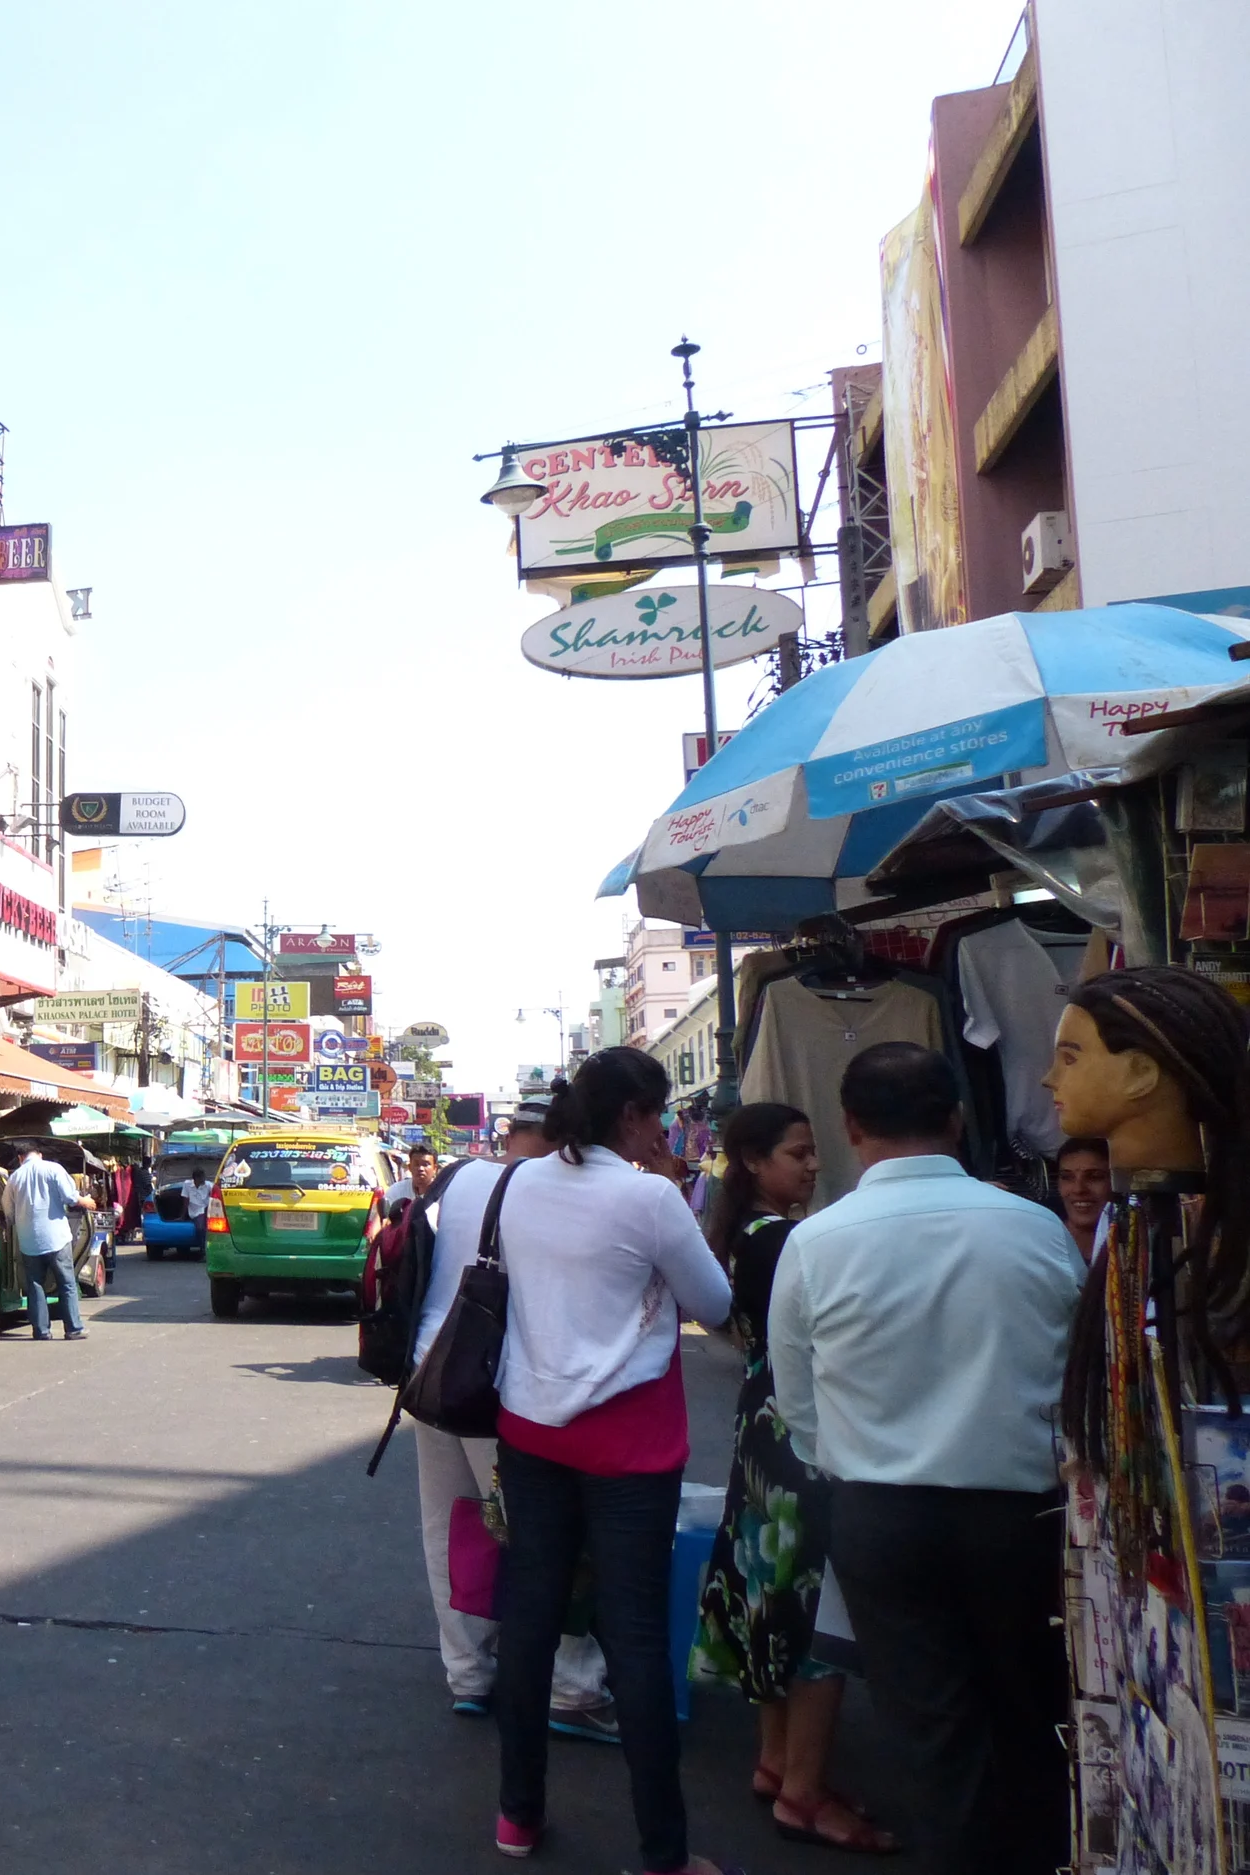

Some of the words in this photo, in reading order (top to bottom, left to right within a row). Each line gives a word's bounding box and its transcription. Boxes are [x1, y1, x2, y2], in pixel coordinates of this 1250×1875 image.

[525, 480, 641, 519] Khao
[610, 647, 661, 669] Irish
[1089, 700, 1170, 720] Happy
[853, 734, 926, 762] Available
[929, 731, 946, 744] at
[950, 719, 983, 738] any
[833, 746, 946, 786] convenience
[950, 729, 1009, 755] stores
[132, 797, 172, 806] BUDGET
[135, 810, 166, 818] ROOM
[667, 807, 713, 832] Happy
[127, 821, 176, 830] AVAILABLE
[669, 819, 715, 846] Tourist
[285, 938, 350, 947] ARAON
[37, 1011, 76, 1021] KHAOSAN
[78, 1010, 109, 1020] PALACE
[111, 1009, 138, 1018] HOTEL
[250, 1003, 291, 1012] PHOTO
[318, 1066, 364, 1081] BAG
